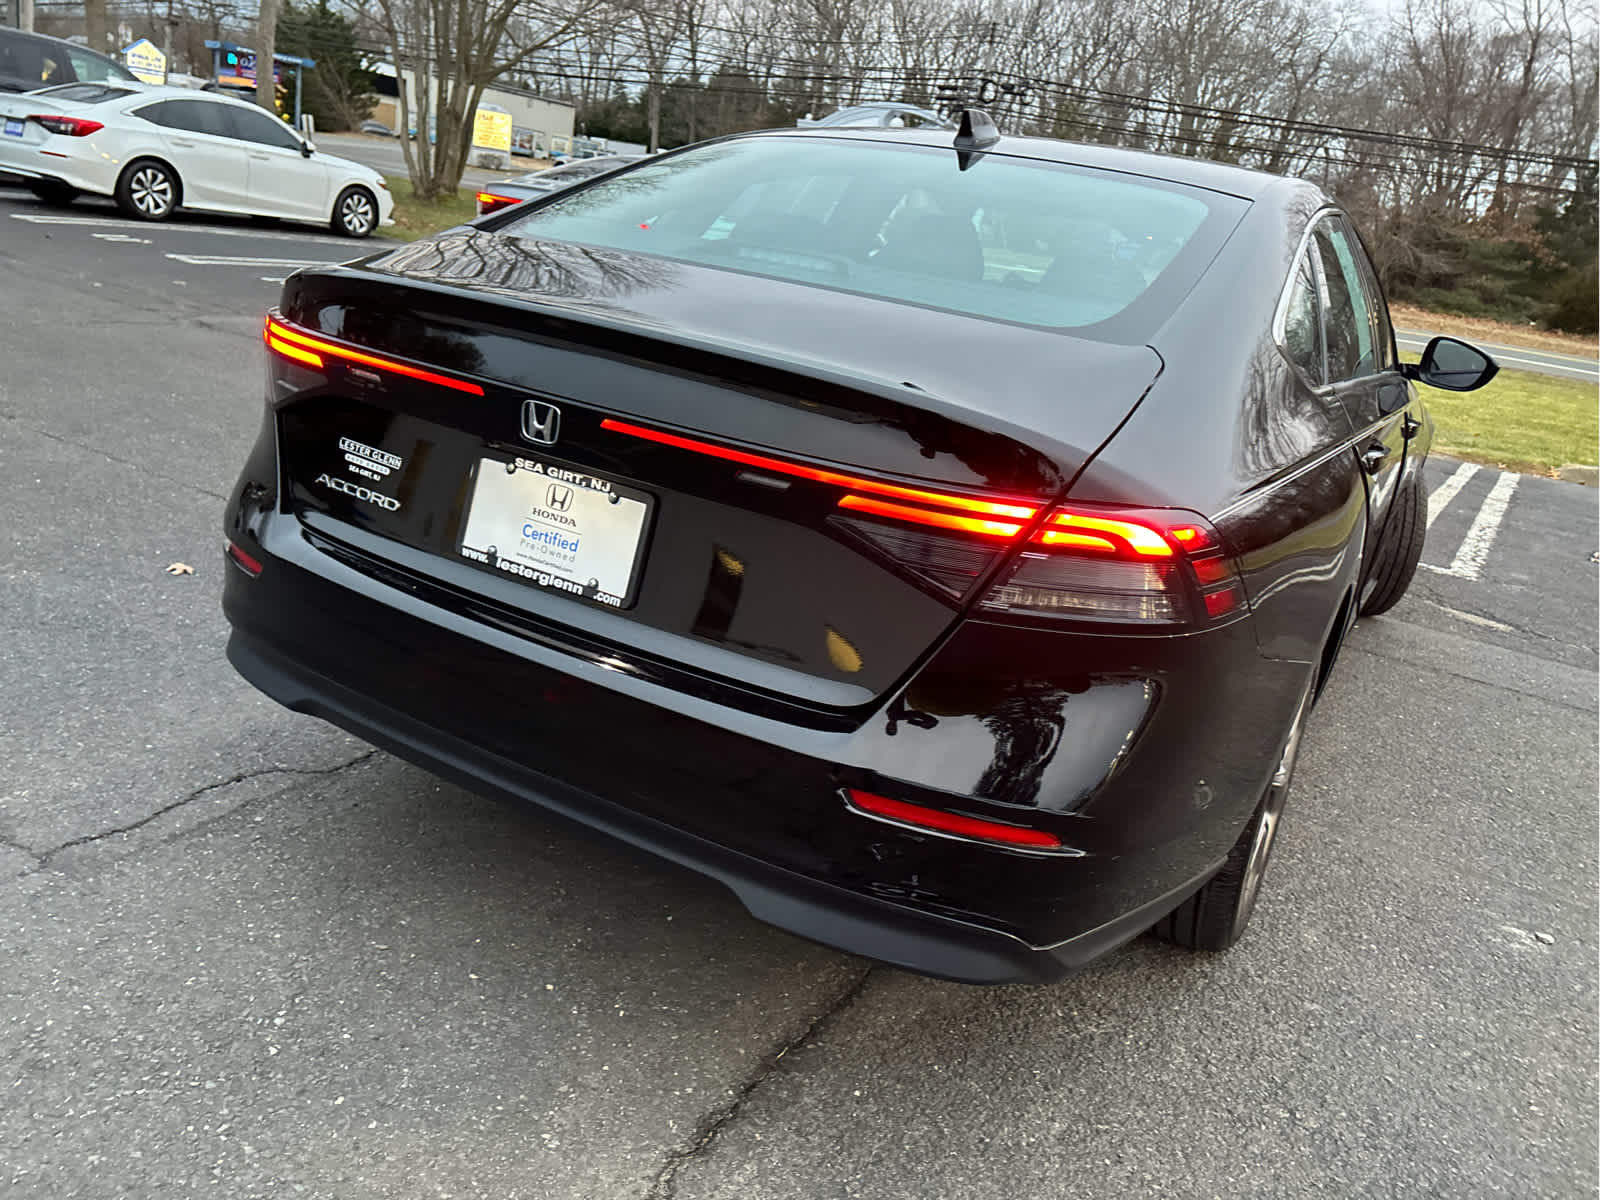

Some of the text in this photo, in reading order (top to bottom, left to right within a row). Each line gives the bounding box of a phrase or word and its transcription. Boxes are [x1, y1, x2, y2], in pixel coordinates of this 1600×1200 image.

[339, 438, 371, 457] LESTER
[372, 451, 402, 468] GLENN
[514, 457, 611, 493] SEA GIRT, NJ
[315, 473, 401, 511] ACCORD
[532, 507, 577, 527] HONDA
[520, 538, 576, 563] Pre-Owned
[522, 524, 580, 552] Certified
[461, 547, 621, 608] www. lesterglenn .com
